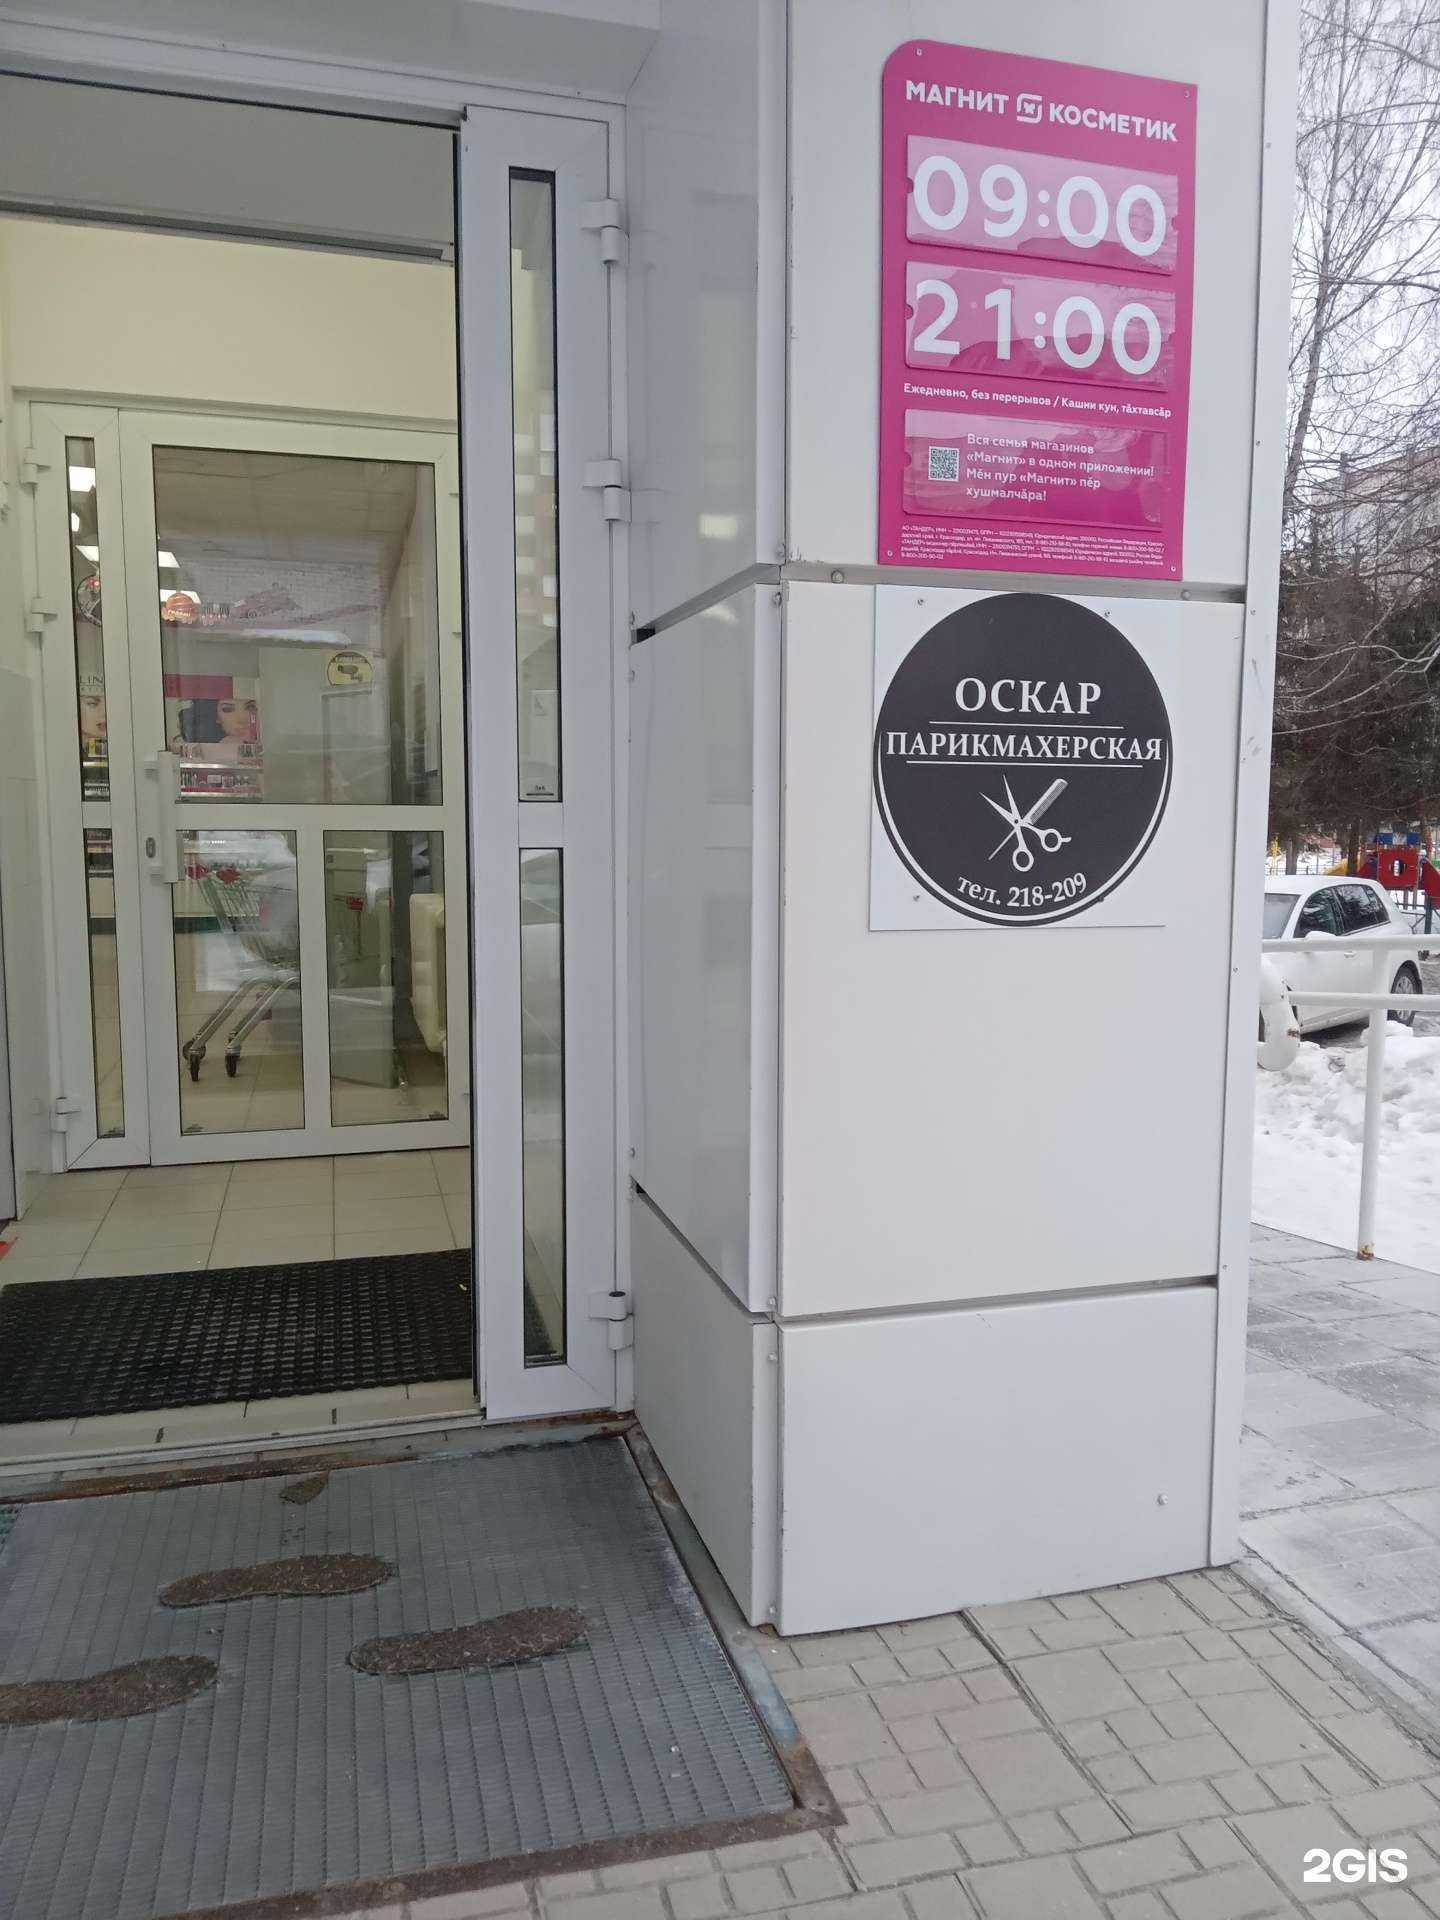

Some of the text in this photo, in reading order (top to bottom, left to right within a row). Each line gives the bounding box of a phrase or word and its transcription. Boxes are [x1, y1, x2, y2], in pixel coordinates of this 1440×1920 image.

[906, 80, 1178, 142] МАГНИТ КОСМЕТИК
[913, 155, 1167, 257] 09:00
[912, 279, 1162, 375] 21:00
[904, 383, 969, 400] Ежедневно,
[971, 389, 990, 400] без
[992, 391, 1051, 406] перерывов
[1061, 397, 1097, 410] Кашни
[1098, 403, 1120, 414] кун,
[967, 433, 1095, 454] Вся семья магазинов
[966, 451, 1155, 477] «Магнит» в одном приложении!
[994, 472, 1017, 484] пур
[1019, 472, 1077, 486] «Магнит»
[955, 677, 1102, 714] ОСКАР
[886, 731, 1162, 760] ПАРИКМАХЕРСКАЯ
[957, 872, 1088, 907] тел. 218-209
